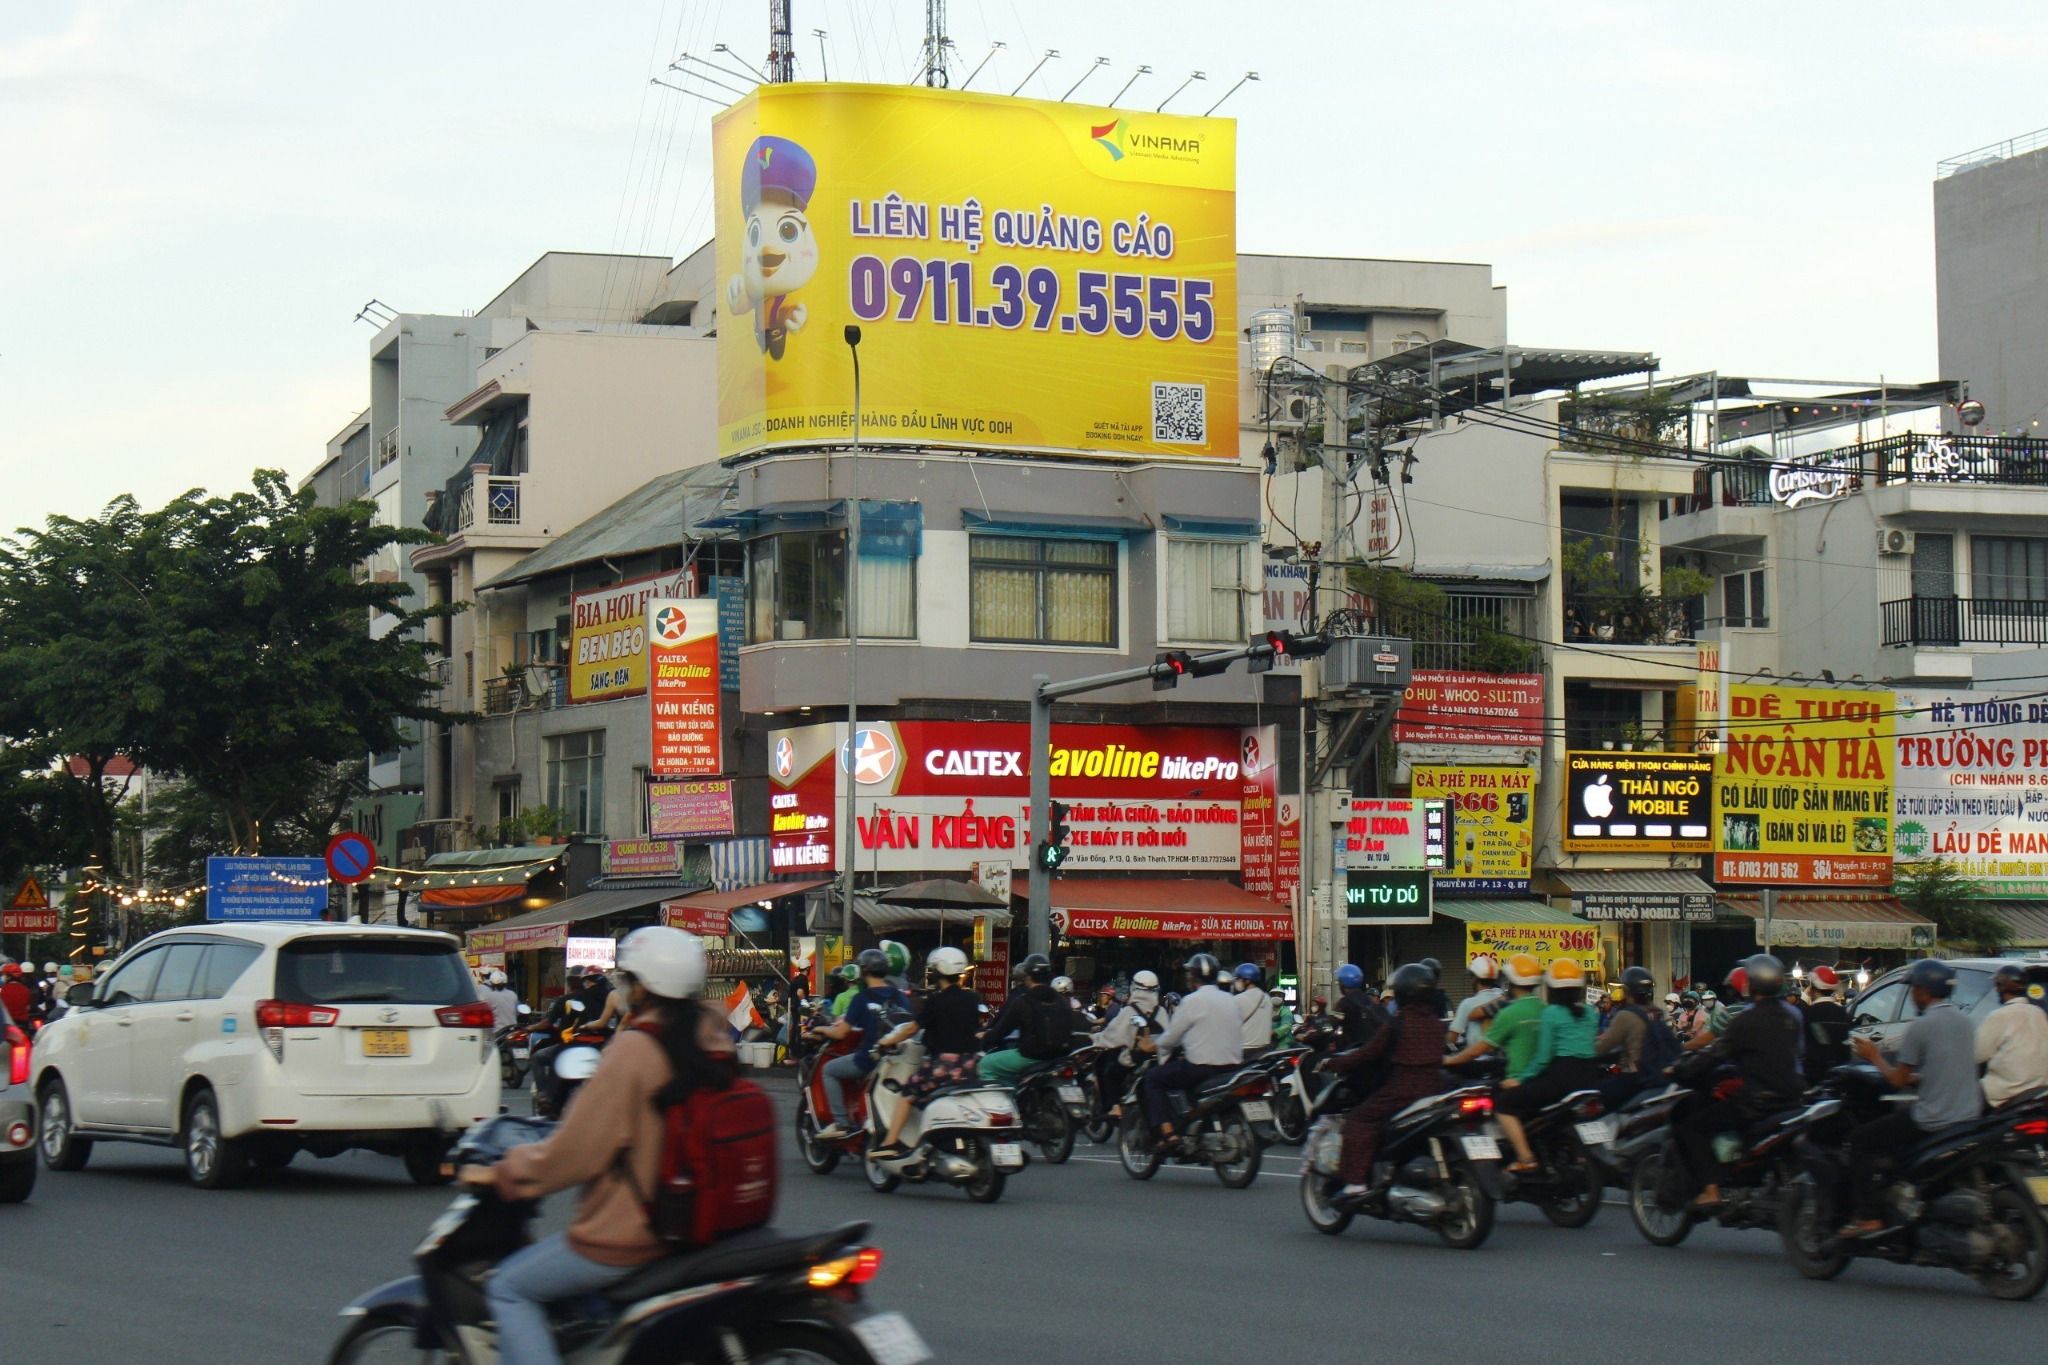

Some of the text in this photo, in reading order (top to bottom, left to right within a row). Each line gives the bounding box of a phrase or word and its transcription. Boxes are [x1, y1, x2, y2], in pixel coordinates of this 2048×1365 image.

[1130, 134, 1200, 152] VINAMA
[850, 193, 1174, 259] LIÊN HỆ QUẢNG CÁO
[850, 255, 1215, 342] 0911.39.5555
[766, 409, 1012, 435] DOANH NGHIỆP HÀNG ĐẦU LĨNH VỰC OOH
[576, 592, 636, 629] BIA HƠI
[657, 655, 688, 664] CALTEX
[1699, 646, 1718, 672] BÁN
[658, 664, 712, 678] Havoline
[658, 679, 686, 688] bikePro
[1417, 688, 1437, 700] HUI
[656, 698, 715, 715] VĂN KIỂNG
[1698, 682, 1718, 712] TRẢ
[1468, 706, 1519, 718] 0913670765
[1731, 694, 1881, 724] DÊ TƯƠI
[1931, 694, 2022, 728] HỆ THỐNG
[1725, 724, 1886, 780] NGÂN HÀ
[1898, 728, 2016, 769] TRƯỜNG
[925, 744, 1238, 780] CALTEX avoline bikePro
[1572, 758, 1590, 770] CỬA
[1590, 758, 1614, 770] HÀNG
[1616, 759, 1636, 772] ĐIỆN
[1637, 760, 1661, 772] THOẠI
[1662, 760, 1686, 771] CHÍNH
[707, 782, 727, 792] 538
[1416, 770, 1434, 788] CÀ
[1440, 770, 1466, 788] PHÊ
[1470, 774, 1497, 788] PHA
[1620, 774, 1700, 796] THÁI NGÔ
[1950, 772, 1976, 786] (CHI
[1244, 796, 1272, 810] Havoline
[1721, 779, 1889, 814] CÓ LẨU ƯỚP SẴN MANG VỀ
[1897, 794, 1906, 815] DÊ
[1910, 796, 1926, 816] TƯƠI
[1928, 794, 1943, 816] ƯỚP
[1962, 798, 1981, 816] THEO
[1984, 796, 1998, 816] YÊU
[2000, 792, 2016, 816] CẦU
[1070, 802, 1096, 823] TÂM
[1098, 802, 1124, 823] SỬA
[1125, 802, 1160, 823] CHỮA
[1166, 802, 1192, 824] BẢO
[1194, 803, 1238, 825] DƯỠNG
[1628, 800, 1689, 816] MOBILE
[856, 798, 1016, 849] VĂN KIỂNG
[1372, 816, 1410, 835] KHOA
[1766, 818, 1794, 844] (BÁN
[1812, 820, 1828, 844] VÀ
[1830, 821, 1846, 844] LẺ)
[1072, 830, 1089, 846] XE
[1090, 826, 1119, 846] MÁY
[1136, 826, 1159, 847] ĐỜI
[1162, 826, 1188, 847] MỚI
[1244, 835, 1255, 847] VĂN
[1932, 821, 1971, 854] LẨU
[1977, 828, 2002, 854] DÊ
[772, 842, 793, 867] VĂN
[1738, 861, 1760, 878] 0703
[1762, 862, 1779, 878] 210
[1781, 862, 1799, 879] 562
[1812, 860, 1832, 880] 364
[1834, 862, 1858, 870] Nguyễn
[1872, 862, 1886, 870] P.13
[1834, 872, 1878, 882] Q.Bình Thạnh
[1369, 884, 1392, 904] TỪ
[1397, 884, 1418, 904] DŨ
[1586, 905, 1614, 919] THÁI
[1614, 904, 1639, 919] NGÔ
[1640, 908, 1680, 920] MOBILE
[1073, 916, 1290, 932] CALTEX Havoline bikePro SỬA XE HONDA TAY
[1486, 926, 1595, 952] CÀ PHÊ PHA 366
